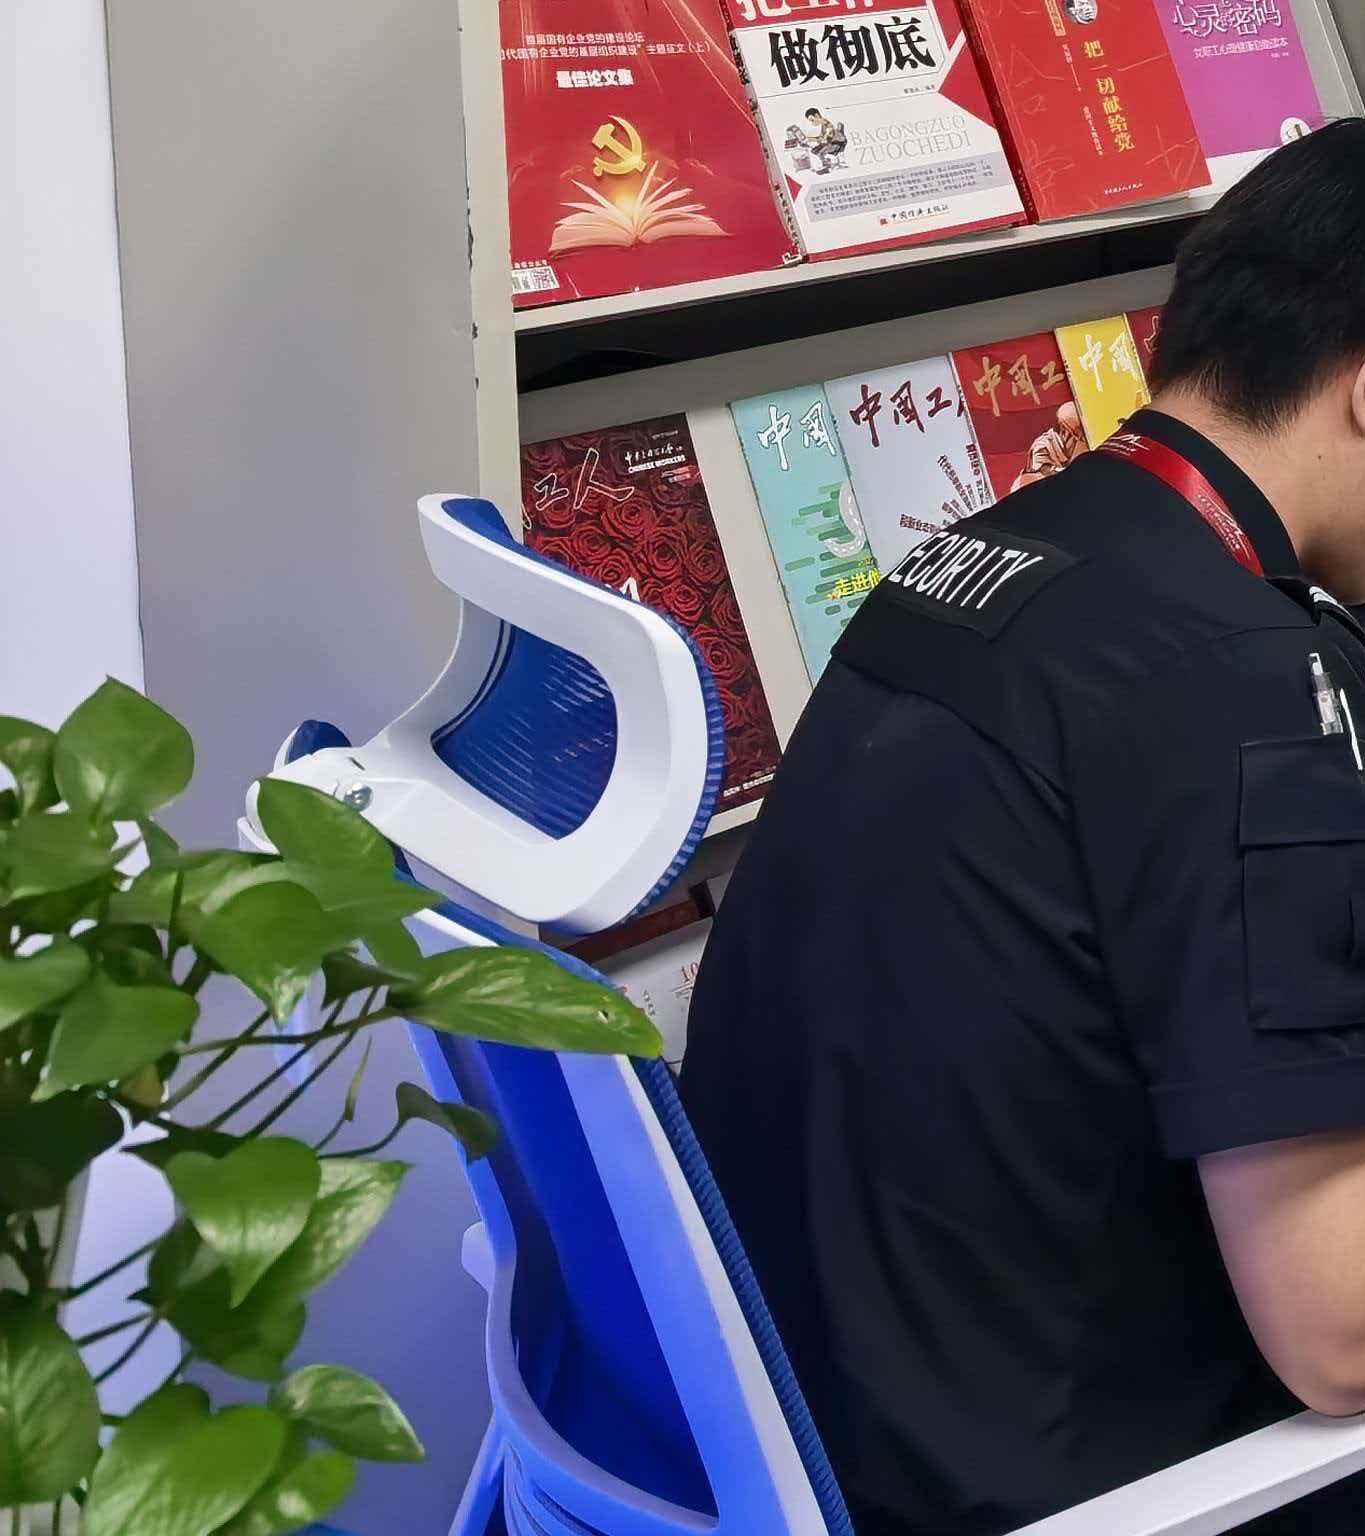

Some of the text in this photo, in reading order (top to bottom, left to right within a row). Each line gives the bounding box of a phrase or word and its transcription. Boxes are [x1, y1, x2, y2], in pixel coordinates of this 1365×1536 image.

[768, 15, 938, 88] 做彻底
[850, 113, 966, 146] BAGONGZUO
[854, 129, 973, 166] ZUOCHEDI
[757, 398, 838, 472] 中国
[888, 531, 1044, 610] ECURITY
